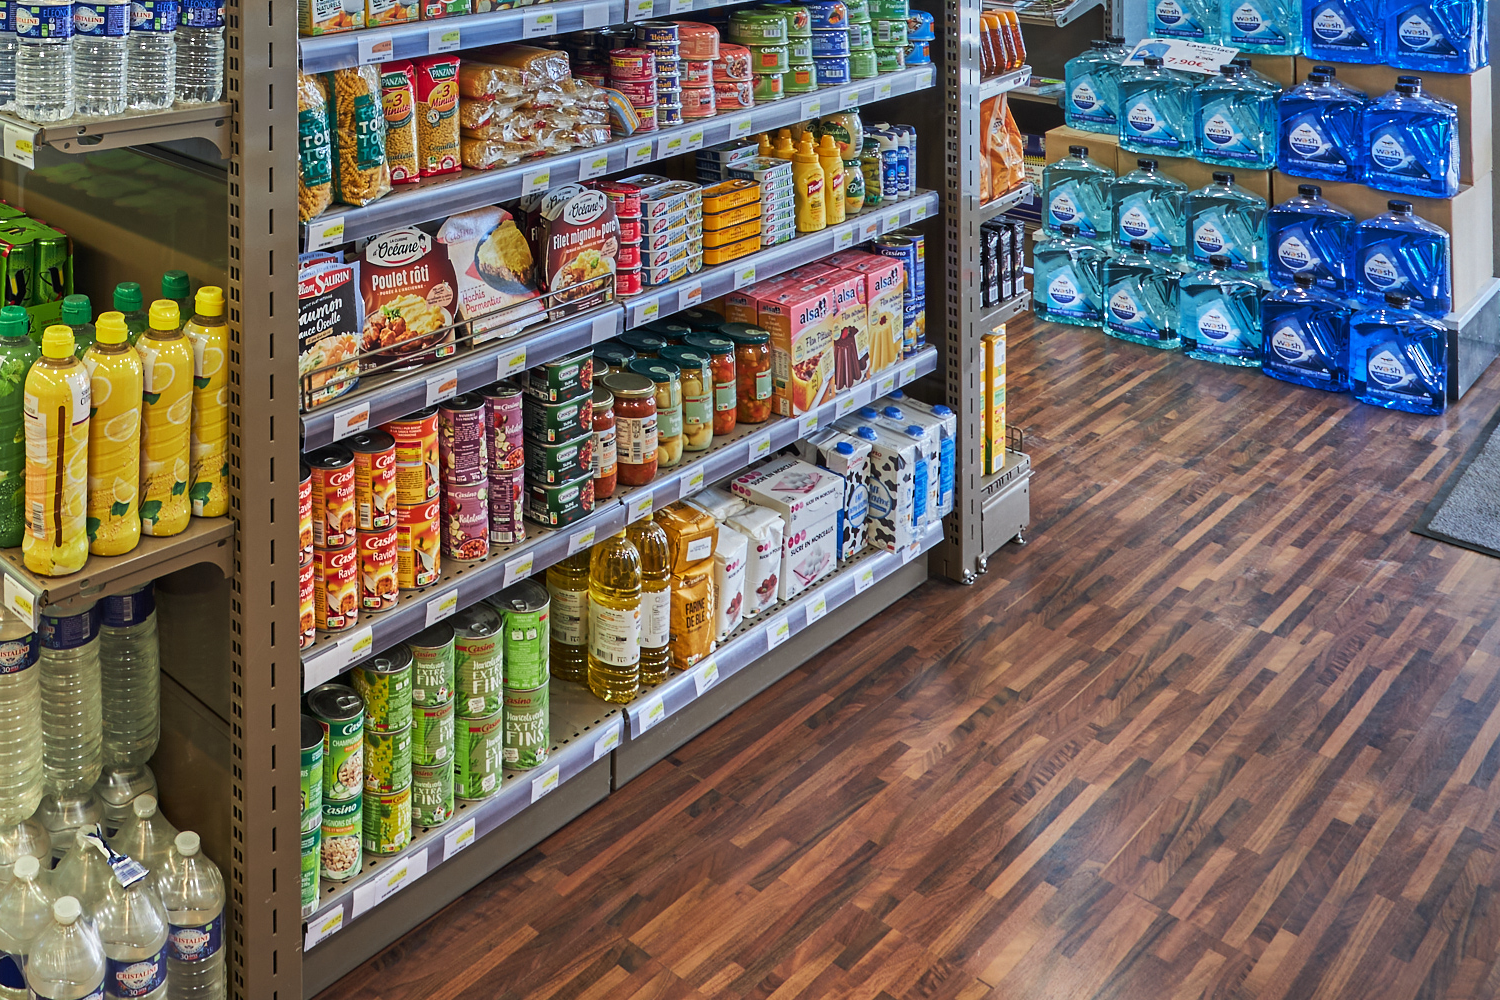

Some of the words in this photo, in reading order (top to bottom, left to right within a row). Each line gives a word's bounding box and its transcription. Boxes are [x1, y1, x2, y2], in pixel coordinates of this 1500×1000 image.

[316, 1, 342, 12] NATURELS
[1167, 56, 1206, 68] 7,90€
[432, 66, 457, 79] PANZANI
[393, 93, 403, 107] 3
[1131, 114, 1153, 122] wash
[553, 233, 570, 250] Filet
[571, 227, 596, 247] mignon
[601, 222, 616, 239] porc
[315, 269, 351, 294] SAURIN
[372, 268, 406, 290] Poulet
[410, 265, 430, 284] rôti
[875, 276, 891, 291] alsa
[462, 291, 486, 305] Hachis
[837, 288, 855, 303] alsa
[465, 294, 502, 313] Parmentier
[299, 298, 343, 325] aumon
[800, 308, 820, 325] alsa
[502, 402, 519, 410] Casino
[751, 474, 768, 486] SUCRE
[774, 460, 800, 474] MORCEAUX
[454, 490, 477, 499] Casino
[790, 542, 804, 556] SUCRE
[811, 525, 834, 543] MORCEAUX
[685, 599, 705, 616] FARINE
[686, 616, 695, 629] DE
[695, 610, 706, 625] BLÉ
[467, 642, 495, 655] Casino
[1, 666, 10, 674] 30
[417, 667, 444, 678] EXTRA
[417, 674, 445, 686] FINS
[506, 720, 544, 733] EXTRA
[506, 727, 545, 746] FINS
[323, 803, 357, 816] Casino
[180, 952, 189, 961] 30
[117, 963, 159, 981] CRISTALINE
